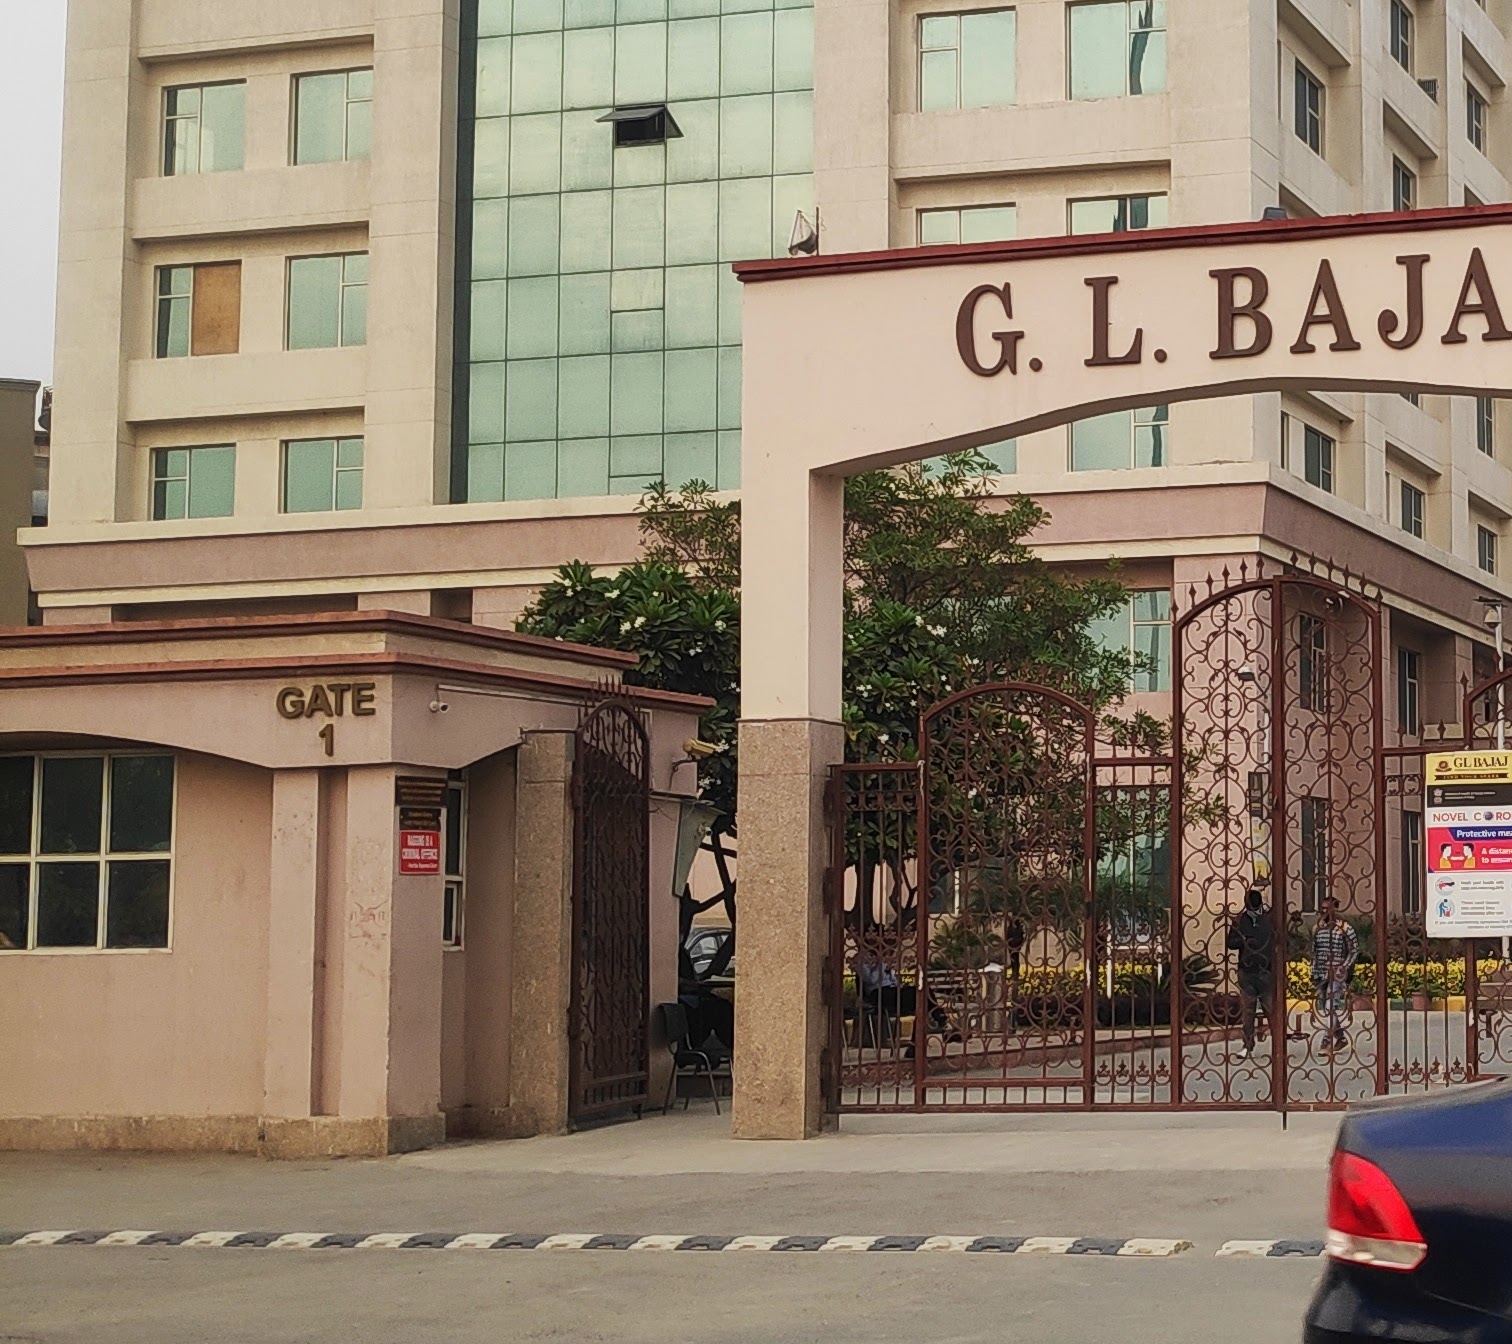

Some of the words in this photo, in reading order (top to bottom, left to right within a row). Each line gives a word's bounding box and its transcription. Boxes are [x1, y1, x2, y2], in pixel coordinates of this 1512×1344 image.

[955, 281, 1043, 377] G.
[1082, 275, 1168, 367] L.
[276, 681, 376, 719] GATE
[318, 723, 334, 757] 1
[1453, 756, 1471, 768] GL
[1473, 755, 1508, 767] BAJAJ
[1433, 812, 1468, 822] NOVEL
[1456, 829, 1497, 838] Protective
